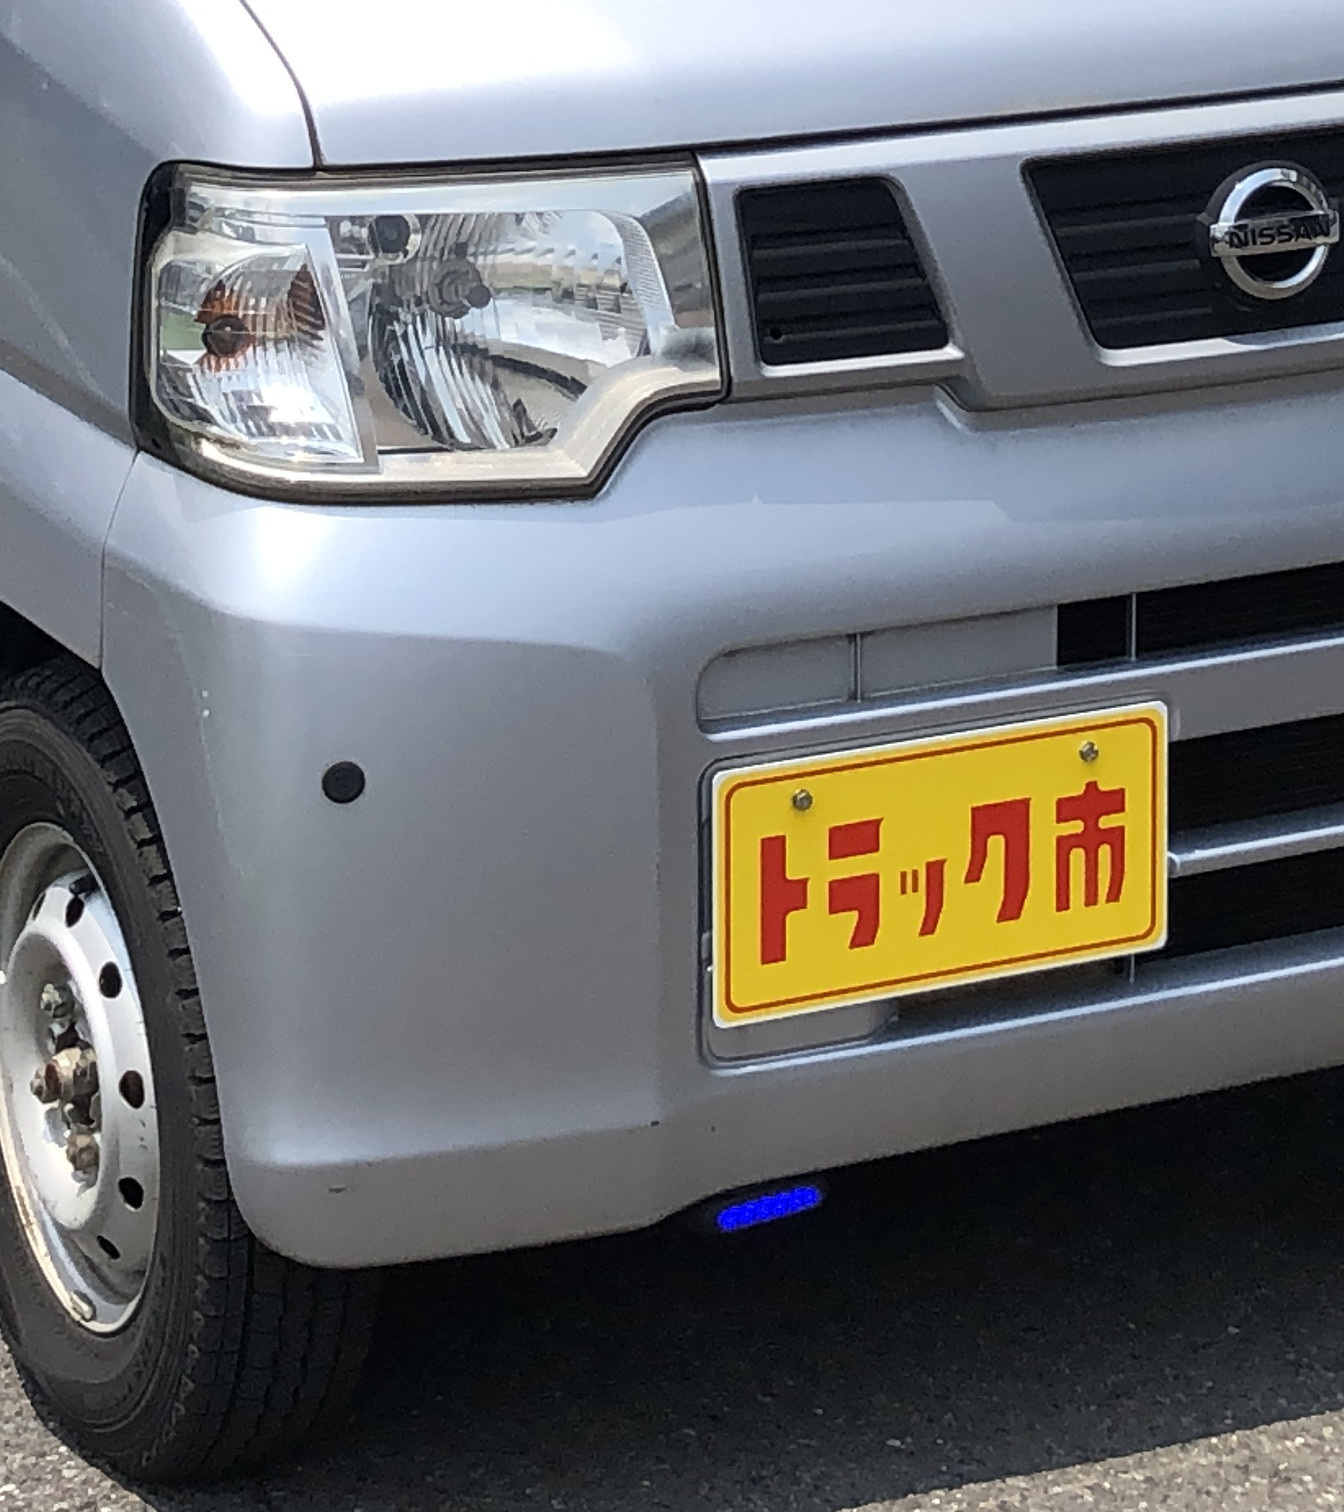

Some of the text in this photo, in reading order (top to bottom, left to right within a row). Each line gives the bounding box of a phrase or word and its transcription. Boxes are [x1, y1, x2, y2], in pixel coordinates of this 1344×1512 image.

[1227, 217, 1330, 249] NISSAN
[759, 780, 1126, 966] トラック市
